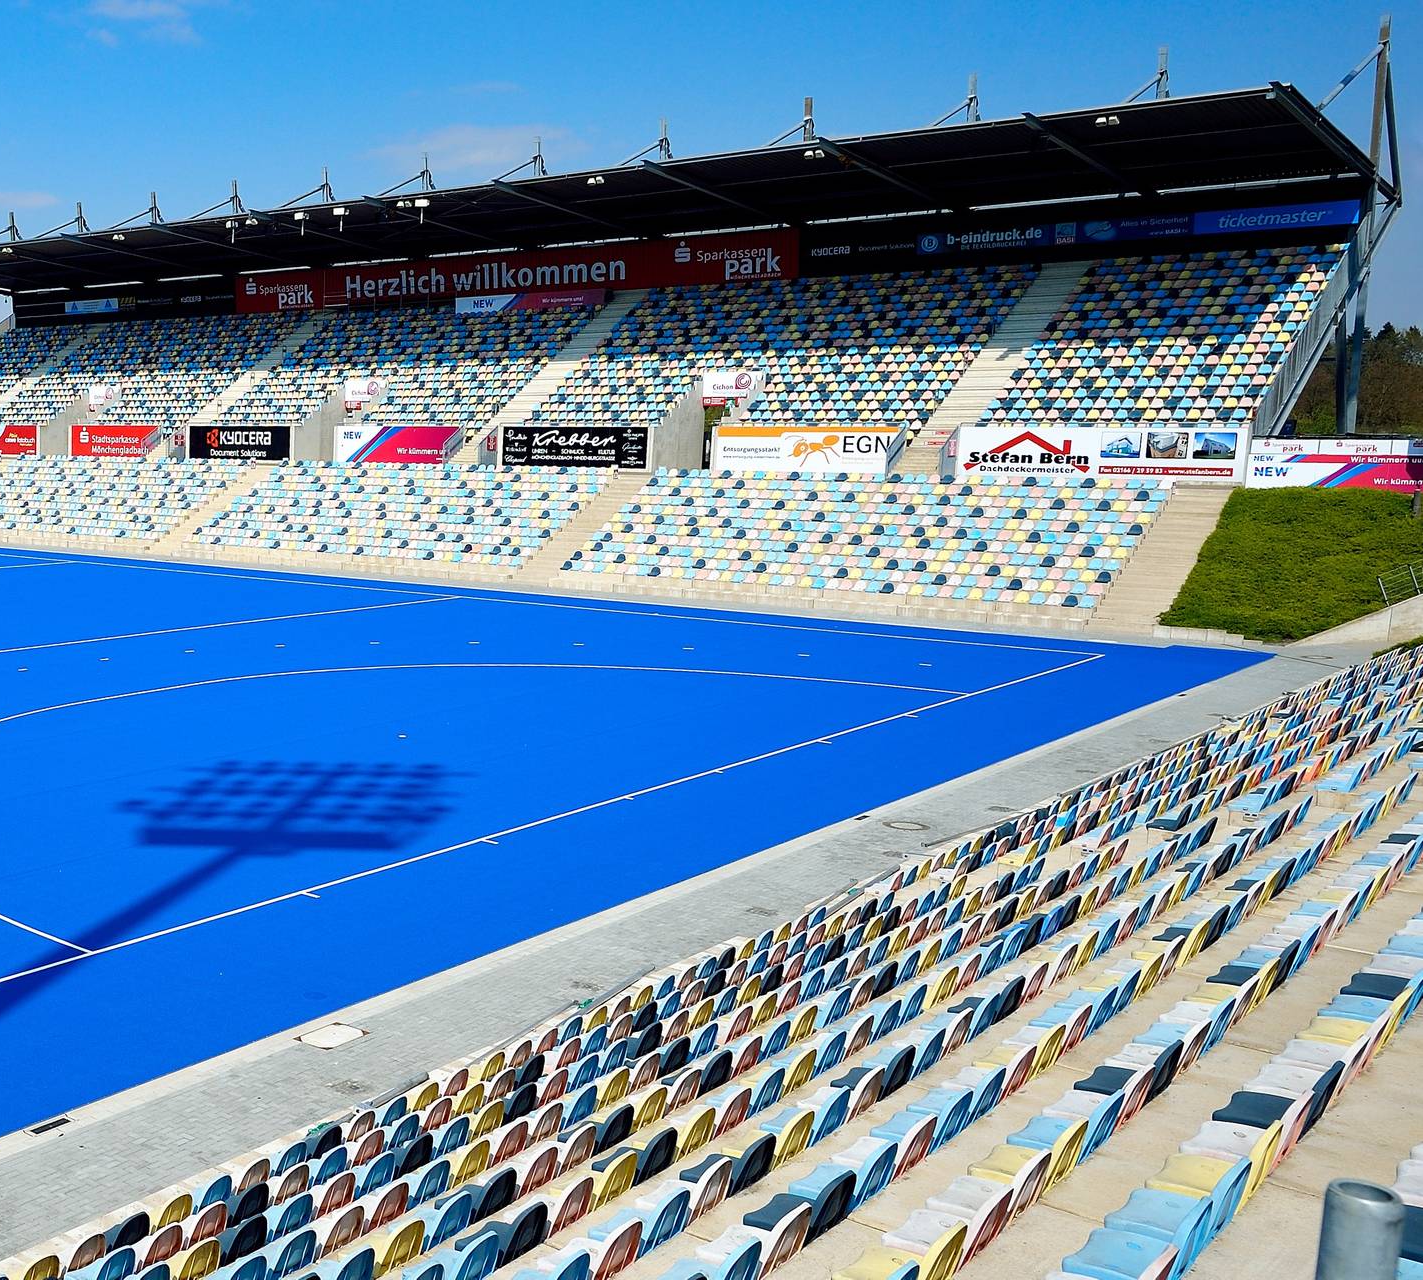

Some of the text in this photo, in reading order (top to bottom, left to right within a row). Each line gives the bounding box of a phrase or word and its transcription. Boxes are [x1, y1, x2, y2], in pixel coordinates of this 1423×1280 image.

[1218, 210, 1326, 228] ticketmaster
[947, 226, 1042, 245] b-eindruck.de
[697, 248, 766, 263] Sparkassen
[811, 246, 851, 256] KYOCERA
[858, 244, 887, 252] Document
[725, 248, 781, 280] park
[345, 259, 626, 298] Herzlich willkommen
[259, 284, 303, 296] Sparkassen
[278, 284, 313, 309] park
[472, 299, 493, 308] NEW
[91, 434, 139, 445] Stadtsparkasse
[220, 431, 271, 446] KYOCERA
[344, 431, 362, 439] NEW
[532, 429, 617, 446] Krebber
[91, 445, 149, 455] Mönchengladbach
[843, 435, 890, 453] EGN
[1283, 445, 1304, 453] park
[1356, 445, 1378, 453] park
[210, 448, 267, 457] Document Solutions
[969, 452, 1089, 465] Stefan Bern
[979, 465, 1075, 474] Dachdeckermeister
[1253, 466, 1289, 477] NEW
